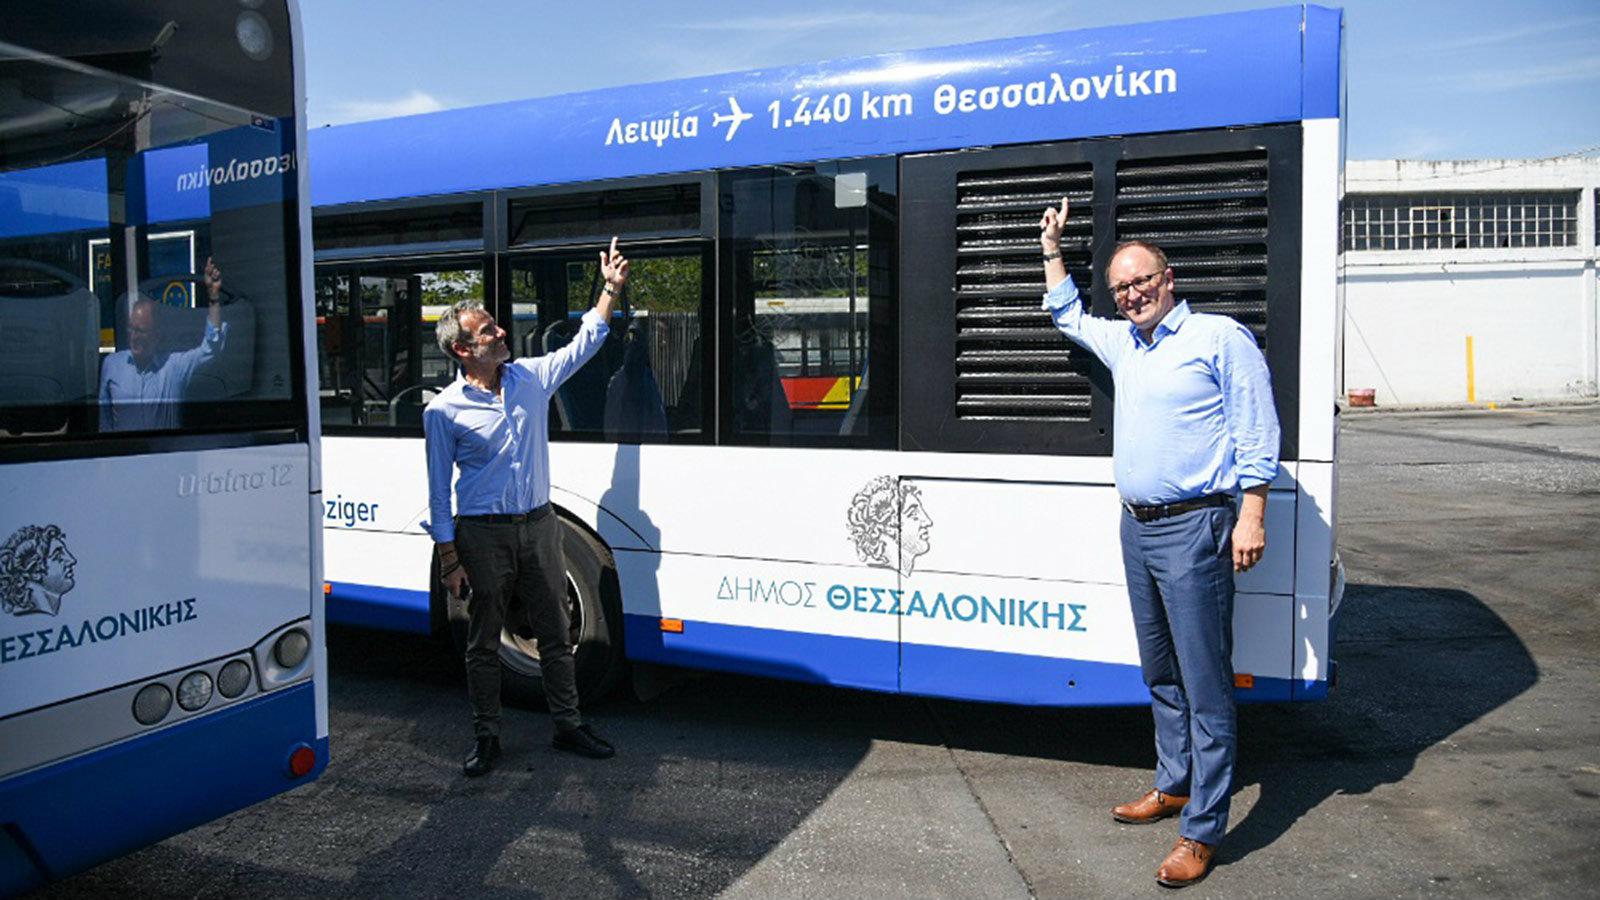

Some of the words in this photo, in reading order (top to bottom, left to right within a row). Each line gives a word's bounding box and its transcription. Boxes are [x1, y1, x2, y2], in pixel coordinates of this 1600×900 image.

[605, 113, 699, 147] Λειψία
[767, 92, 852, 130] 1.440
[860, 91, 914, 121] km
[177, 468, 265, 498] Urbino
[271, 464, 294, 487] 12
[321, 494, 379, 527] ziger
[716, 576, 817, 608] ΔΗΜΟΣ
[826, 584, 1088, 632] ΘΕΣΣΑΛΟΝΙΚΗΣ
